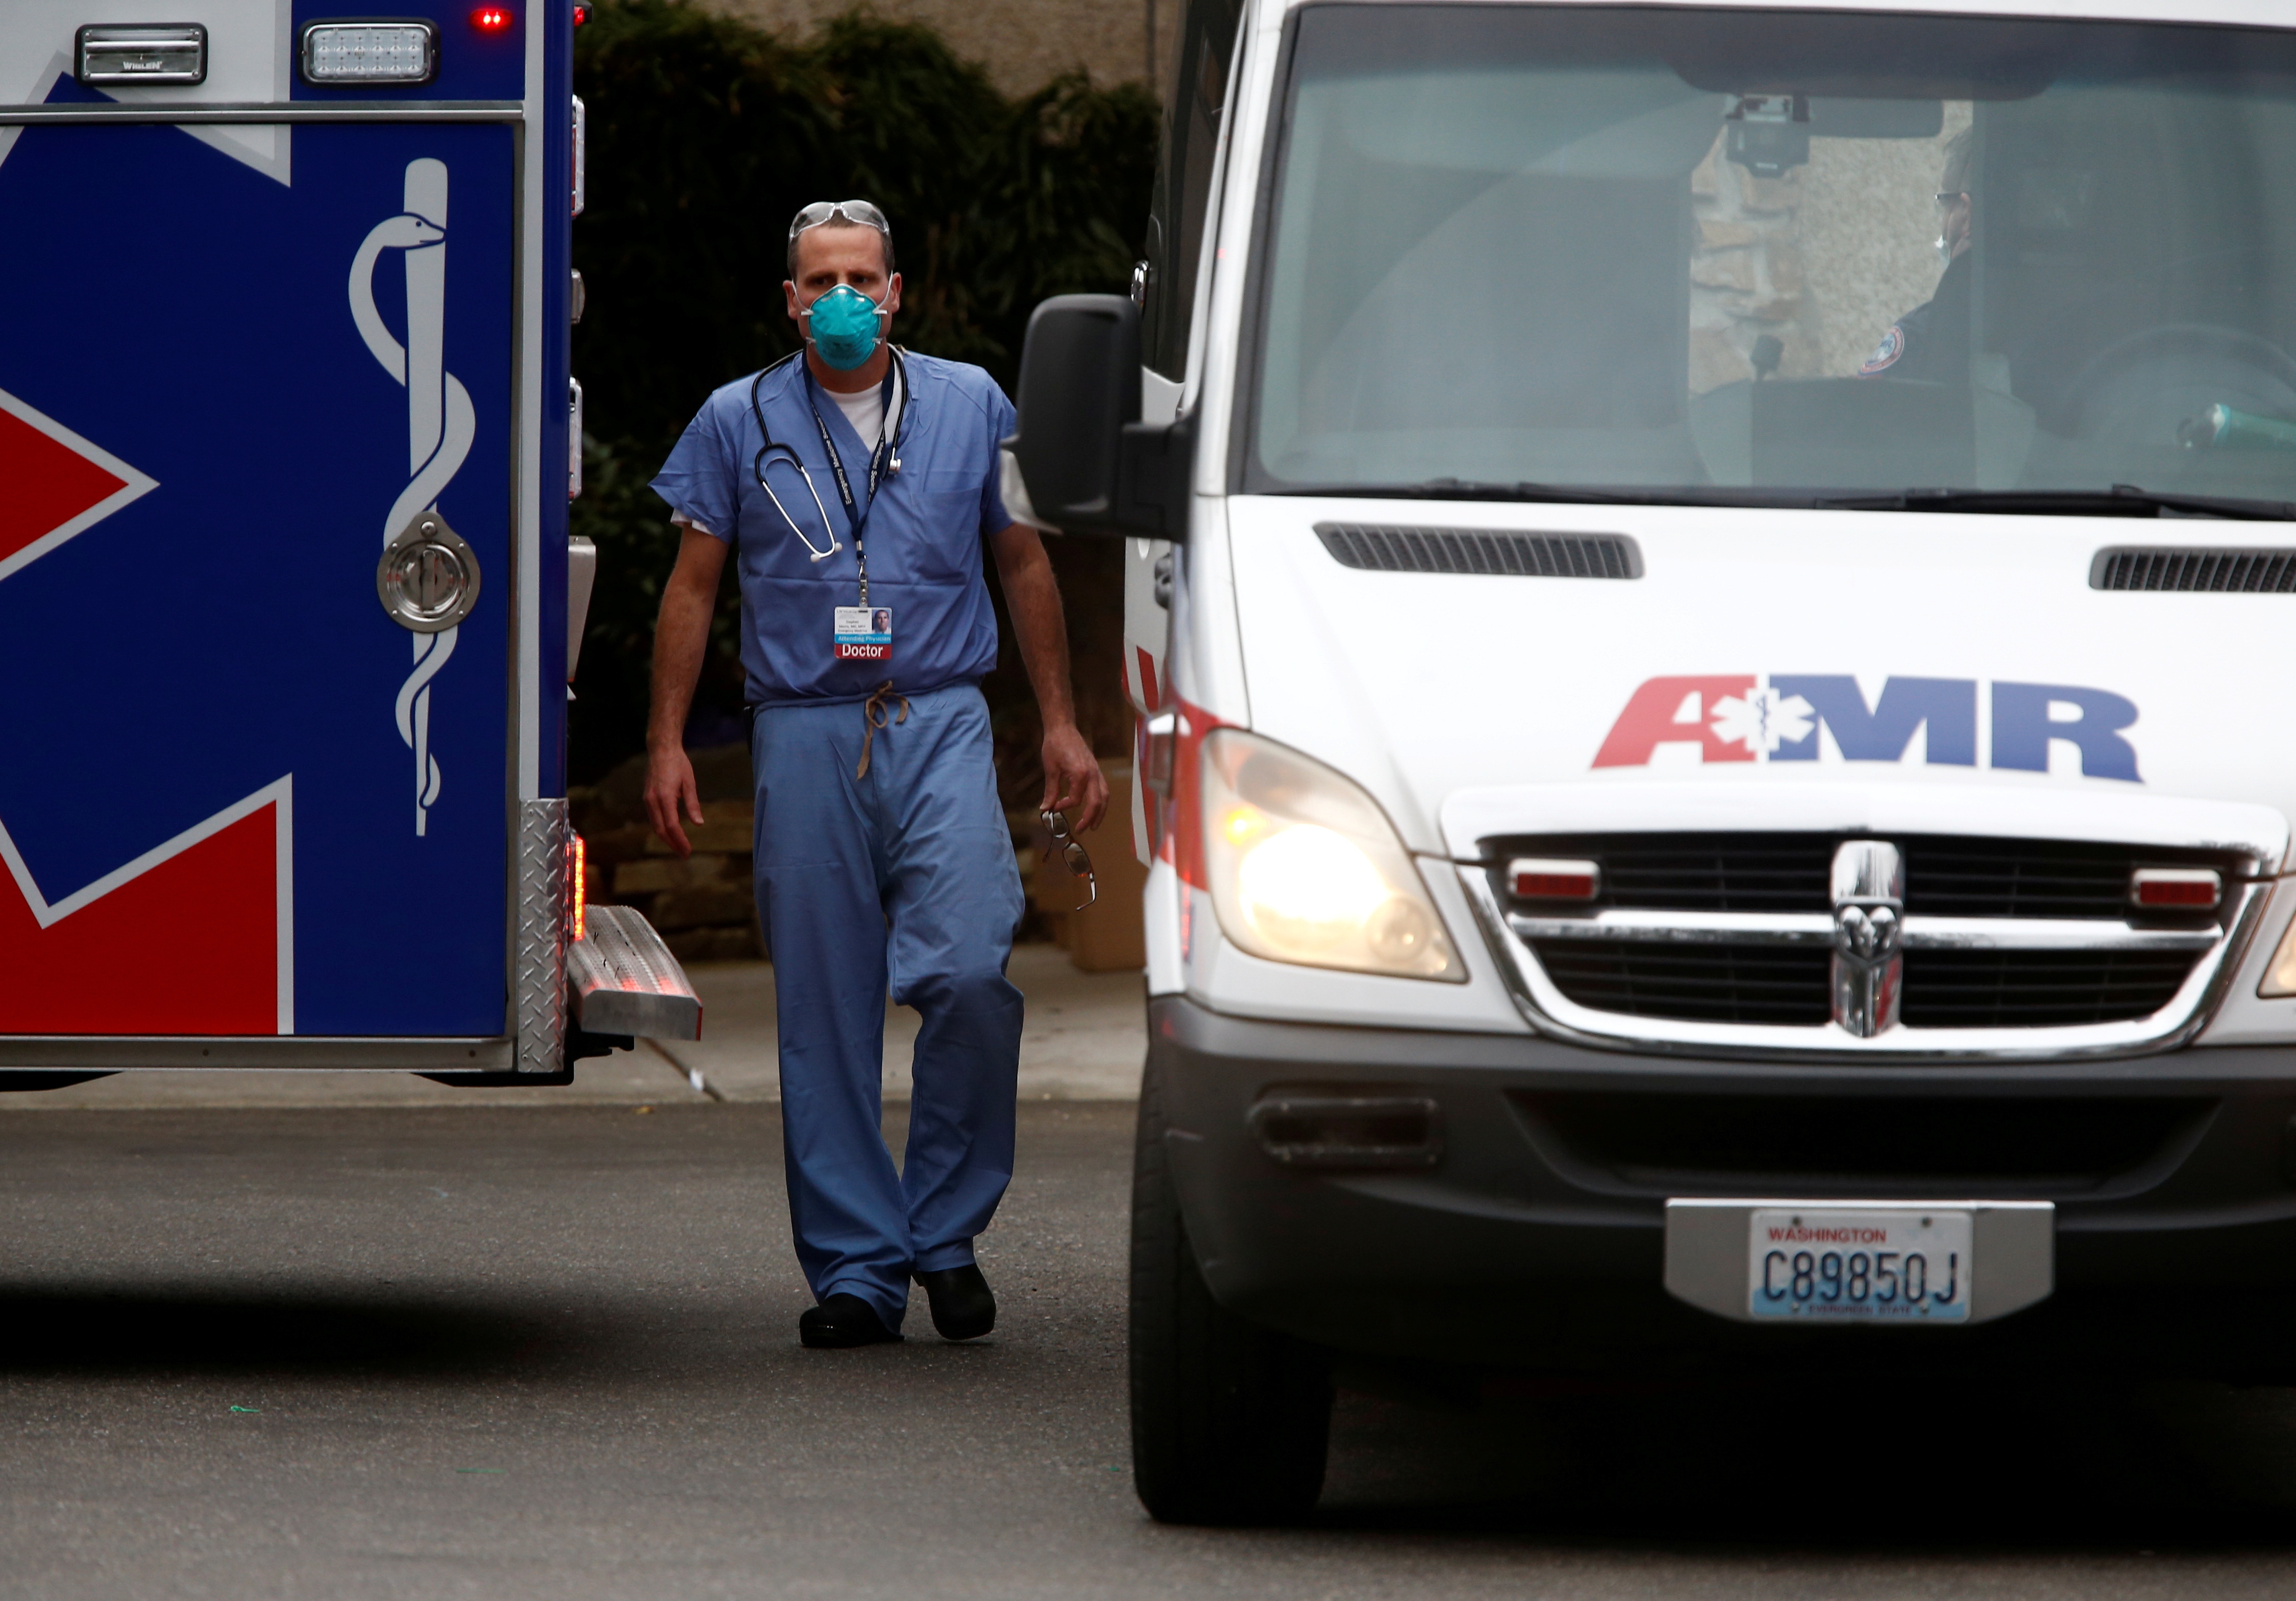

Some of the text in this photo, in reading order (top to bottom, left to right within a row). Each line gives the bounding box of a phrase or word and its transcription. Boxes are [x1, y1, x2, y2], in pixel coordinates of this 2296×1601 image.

[123, 61, 161, 70] WHELEN
[826, 439, 840, 468] Medicine
[837, 468, 852, 505] Emergency
[842, 644, 883, 657] Doctor
[1588, 673, 2146, 783] AMR
[1768, 1227, 1887, 1243] WASHINGTON
[1764, 1249, 1958, 1304] C89850J
